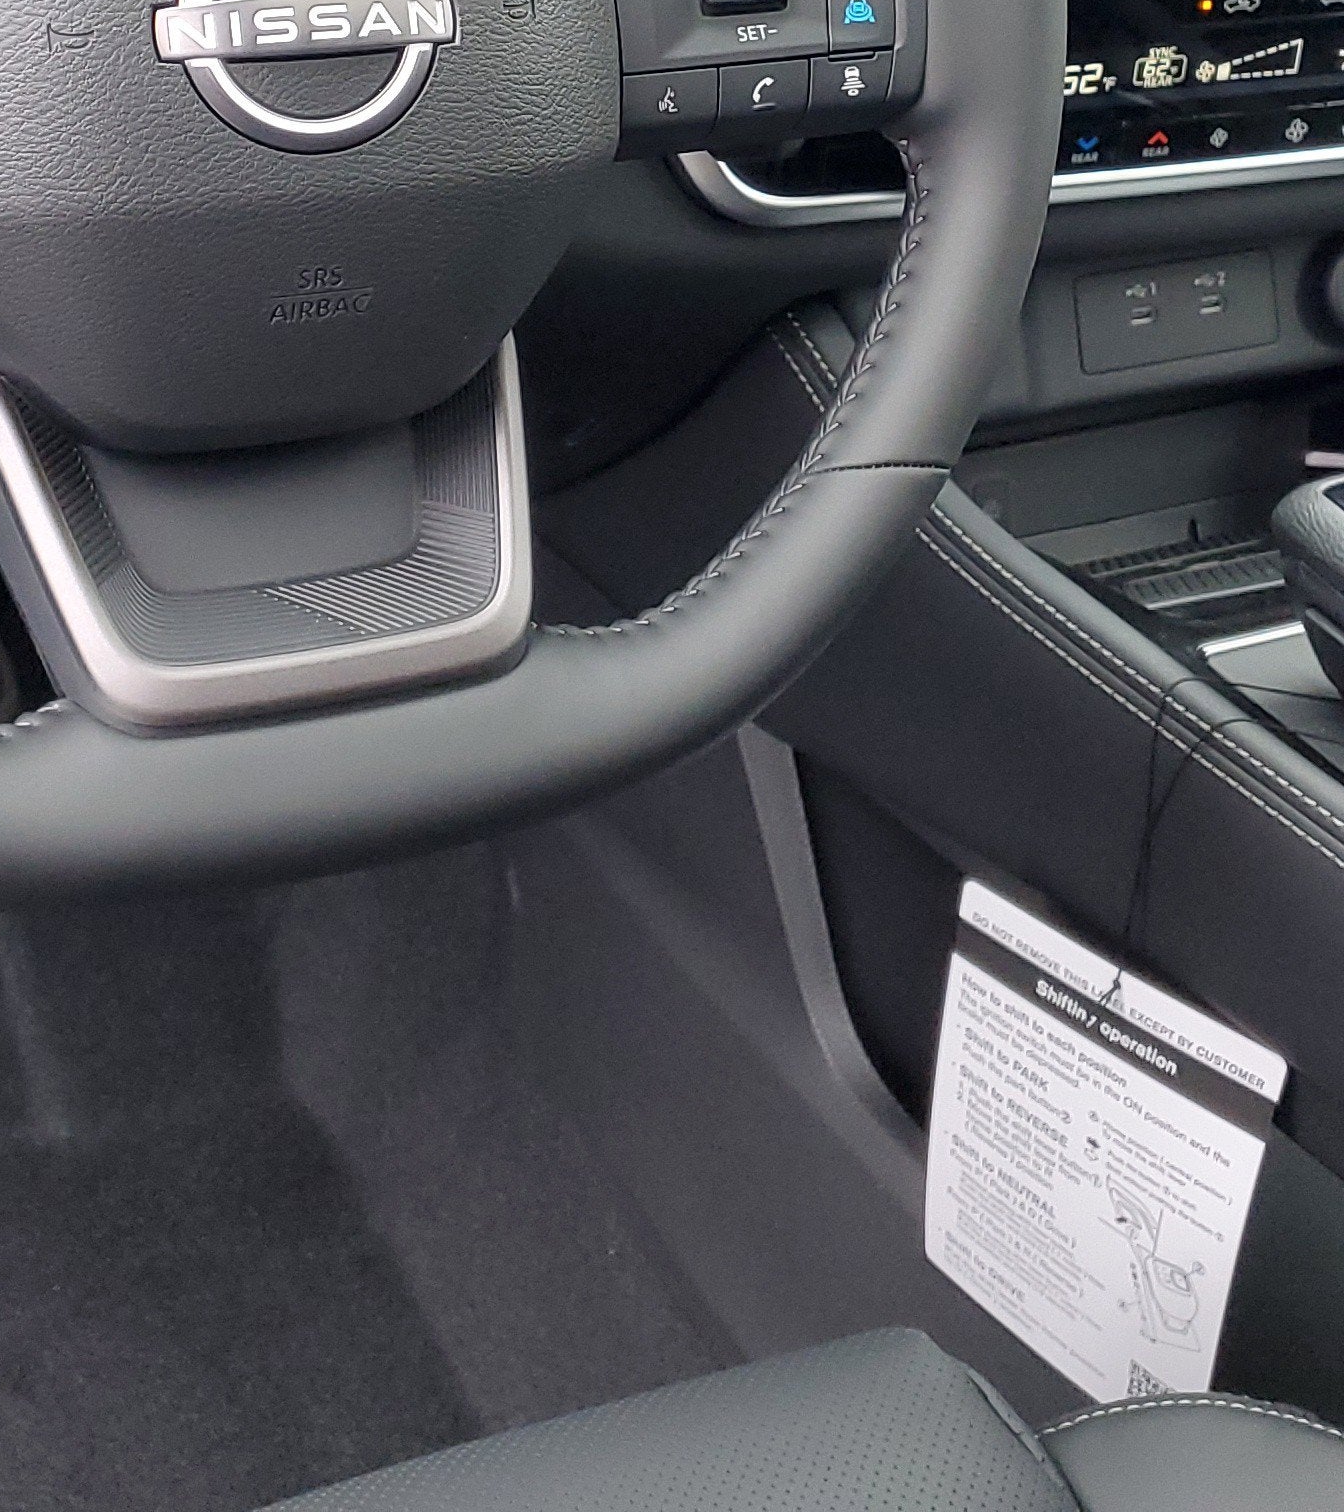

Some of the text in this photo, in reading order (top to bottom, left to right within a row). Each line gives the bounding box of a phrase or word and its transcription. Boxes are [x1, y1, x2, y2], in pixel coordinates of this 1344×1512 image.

[1149, 46, 1178, 59] SYNC
[298, 266, 344, 290] SRS
[269, 293, 372, 325] AIRBAG
[990, 921, 1014, 945] NOT
[1015, 936, 1059, 973] REMOVE
[1062, 965, 1088, 991] THIS
[1090, 982, 1126, 1013] LEL
[1128, 1004, 1175, 1041] EXCEPT
[1176, 1033, 1194, 1051] BY
[1195, 1042, 1265, 1092] CUSTOMER
[1098, 1018, 1178, 1079] operation
[1011, 1057, 1049, 1094] PARK
[1077, 1049, 1127, 1090] position
[1005, 1095, 1068, 1149] REVERSE
